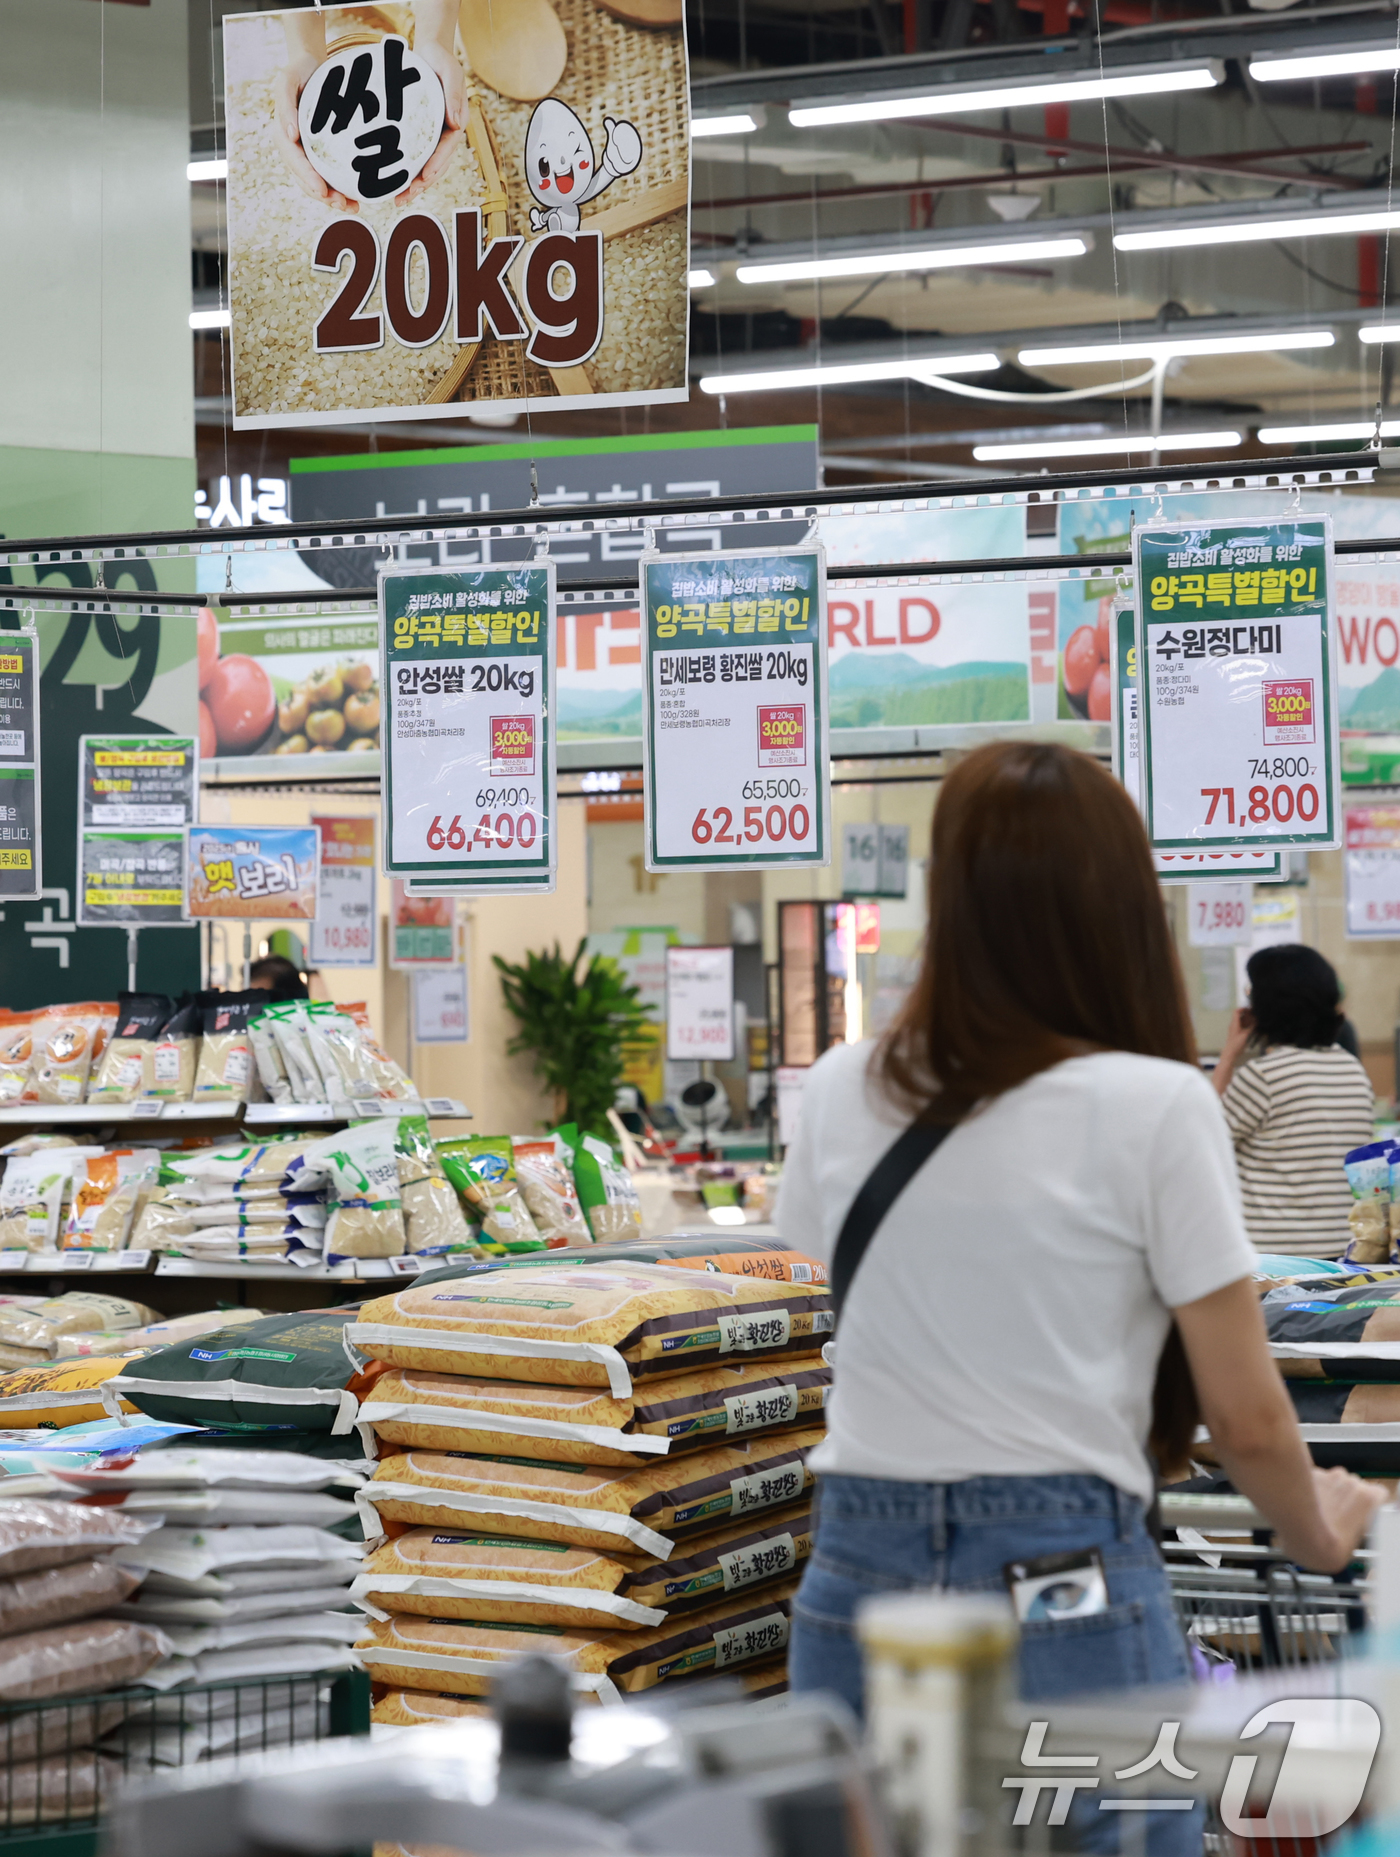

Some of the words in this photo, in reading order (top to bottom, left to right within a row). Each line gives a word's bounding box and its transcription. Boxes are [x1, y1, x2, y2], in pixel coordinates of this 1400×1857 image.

[311, 38, 421, 199] 쌀
[312, 208, 602, 366] 20kg
[1167, 550, 1217, 569] 집밥소비
[1220, 547, 1273, 566] 활성화를
[1275, 544, 1303, 562] 위한
[671, 580, 718, 598] 집밥소비
[720, 577, 770, 595] 활성화를
[771, 575, 797, 592] 위한
[1150, 567, 1317, 611] 양곡특별할인
[408, 592, 453, 610] 집밥소비
[504, 589, 528, 605] 위한
[656, 597, 810, 638] 양곡특별할인
[393, 611, 540, 649] 양곡특별할인
[1156, 624, 1282, 661] 수원정다미
[660, 655, 716, 685] 만세보령
[720, 652, 763, 683] 황진쌀
[766, 651, 808, 686] 20kg
[1155, 663, 1184, 673] 20kg/포
[397, 665, 465, 695] 안성쌀
[470, 664, 534, 698] 20kg
[660, 687, 686, 697] 20kg/포
[1284, 687, 1302, 696] 20kg
[660, 709, 700, 719] 100g/328원
[777, 711, 794, 720] 20kg
[509, 722, 525, 730] 20kg
[1247, 757, 1309, 780] 74,800
[475, 787, 529, 809] 69,400
[742, 778, 801, 801] 65,500
[1200, 783, 1319, 827] 71,800
[0, 827, 31, 841] 립니다.
[426, 812, 536, 852] 66,400
[691, 804, 810, 845] 62,500
[1197, 902, 1246, 930] 7,980
[197, 1351, 213, 1359] NH
[663, 1339, 674, 1348] NH
[669, 1425, 681, 1434] NH
